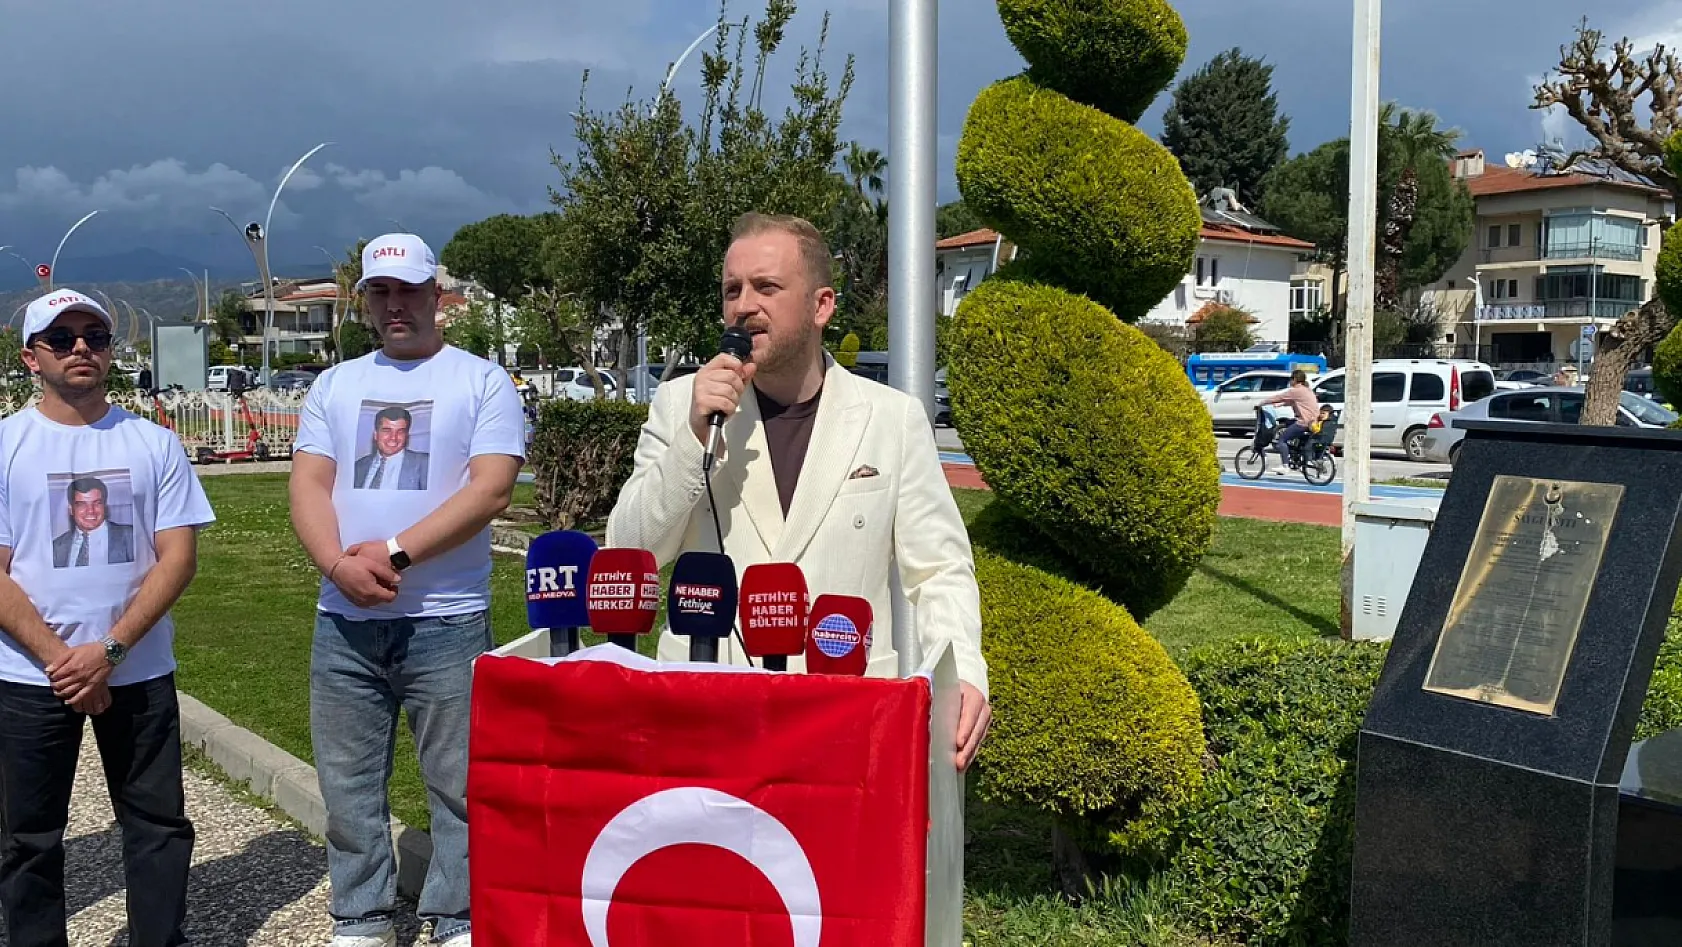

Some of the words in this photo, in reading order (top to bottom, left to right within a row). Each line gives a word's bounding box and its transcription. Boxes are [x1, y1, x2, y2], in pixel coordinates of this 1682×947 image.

[373, 247, 406, 261] ÇATLI
[526, 565, 578, 593] FRT
[593, 571, 632, 582] FETHİYE
[542, 591, 576, 599] MEDYA
[592, 586, 632, 596] HABER
[687, 587, 720, 598] HABER
[748, 590, 797, 603] FETHİYE
[589, 600, 634, 610] MERKEZİ
[678, 597, 713, 611] Fethiye
[752, 605, 794, 616] HABER
[749, 614, 798, 628] BÜLTENİ
